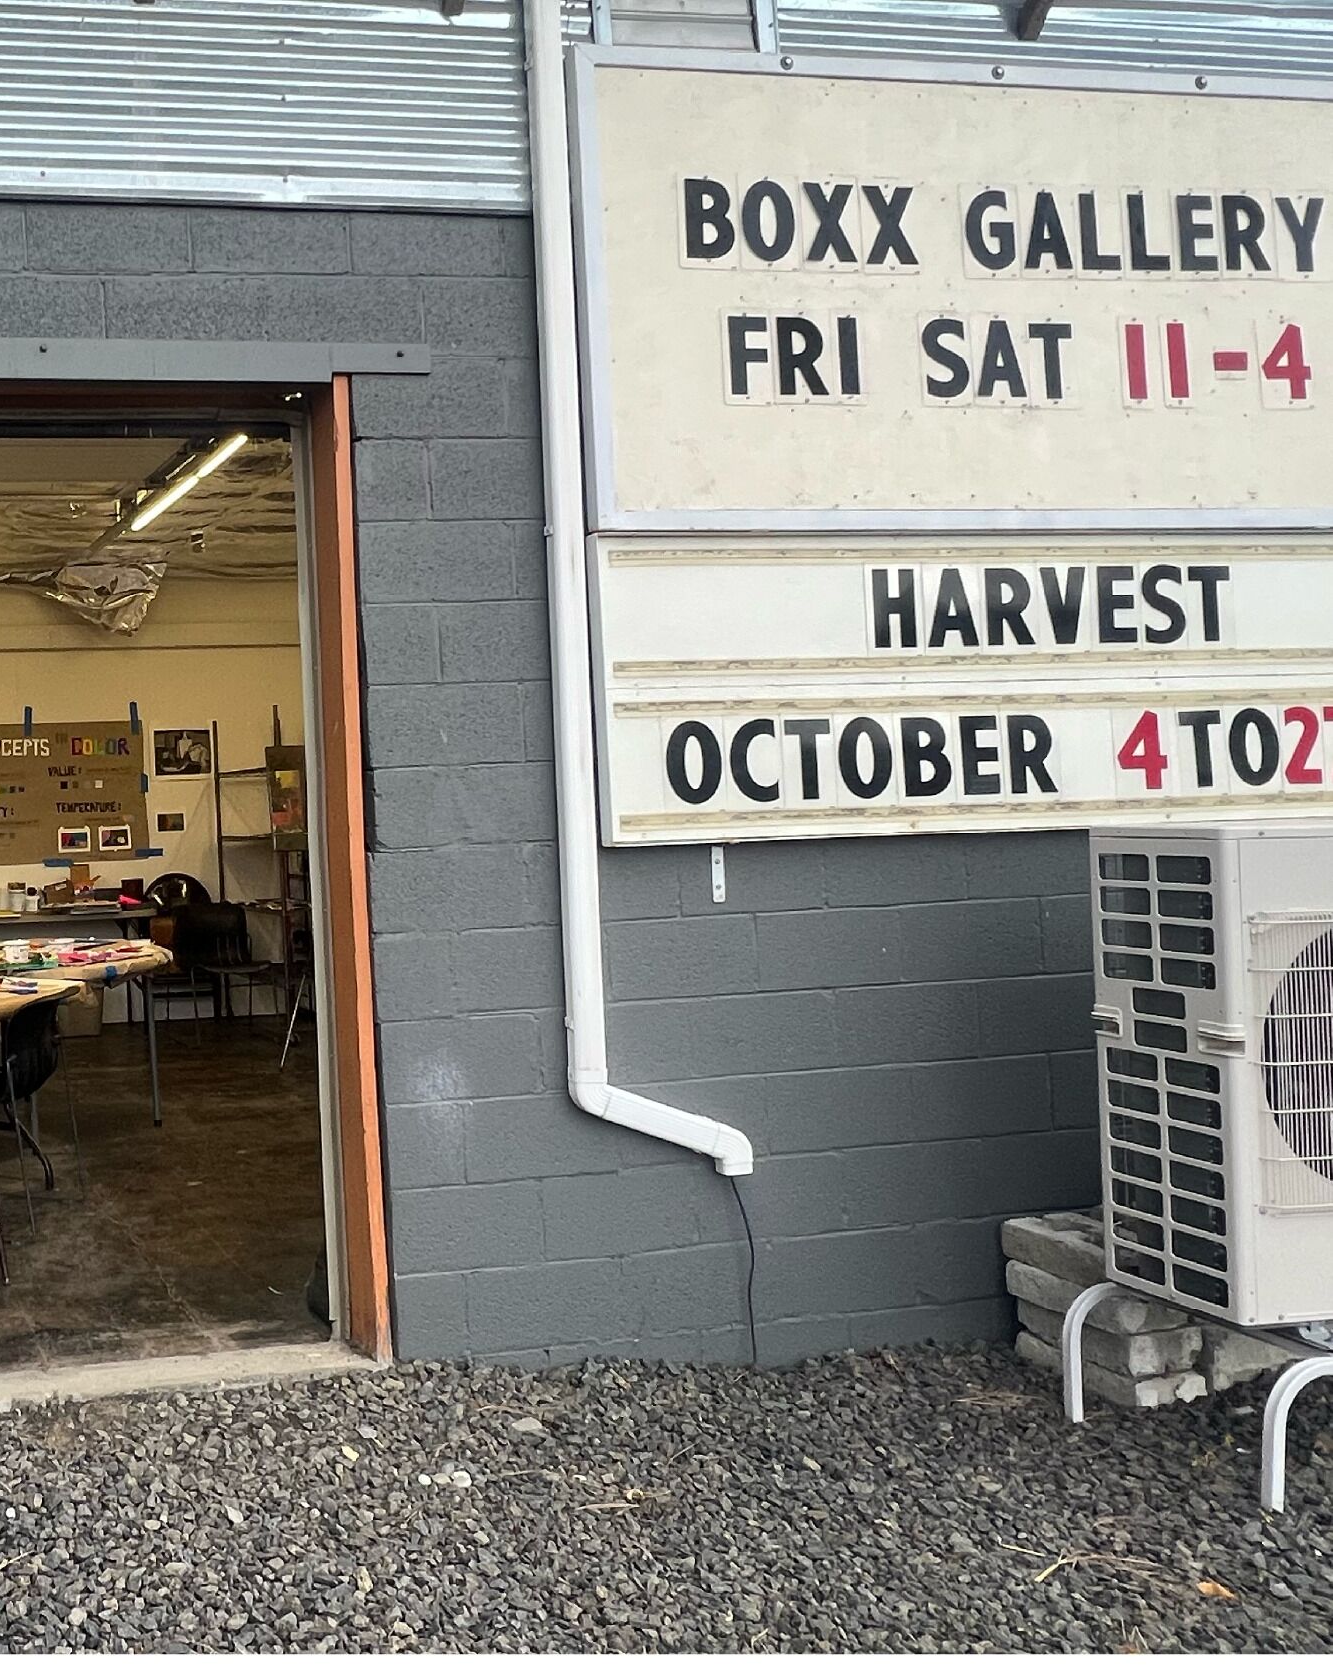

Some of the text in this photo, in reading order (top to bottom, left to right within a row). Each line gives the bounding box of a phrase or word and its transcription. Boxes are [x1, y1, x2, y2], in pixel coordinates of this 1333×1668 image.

[683, 177, 1325, 272] BOXX GALLERY
[727, 316, 861, 397] FRI
[920, 318, 1072, 399] SAT
[871, 564, 1230, 649] HARVEST
[71, 737, 130, 756] COLOR
[665, 714, 1059, 804] OCTOBER
[1284, 706, 1333, 784] 2
